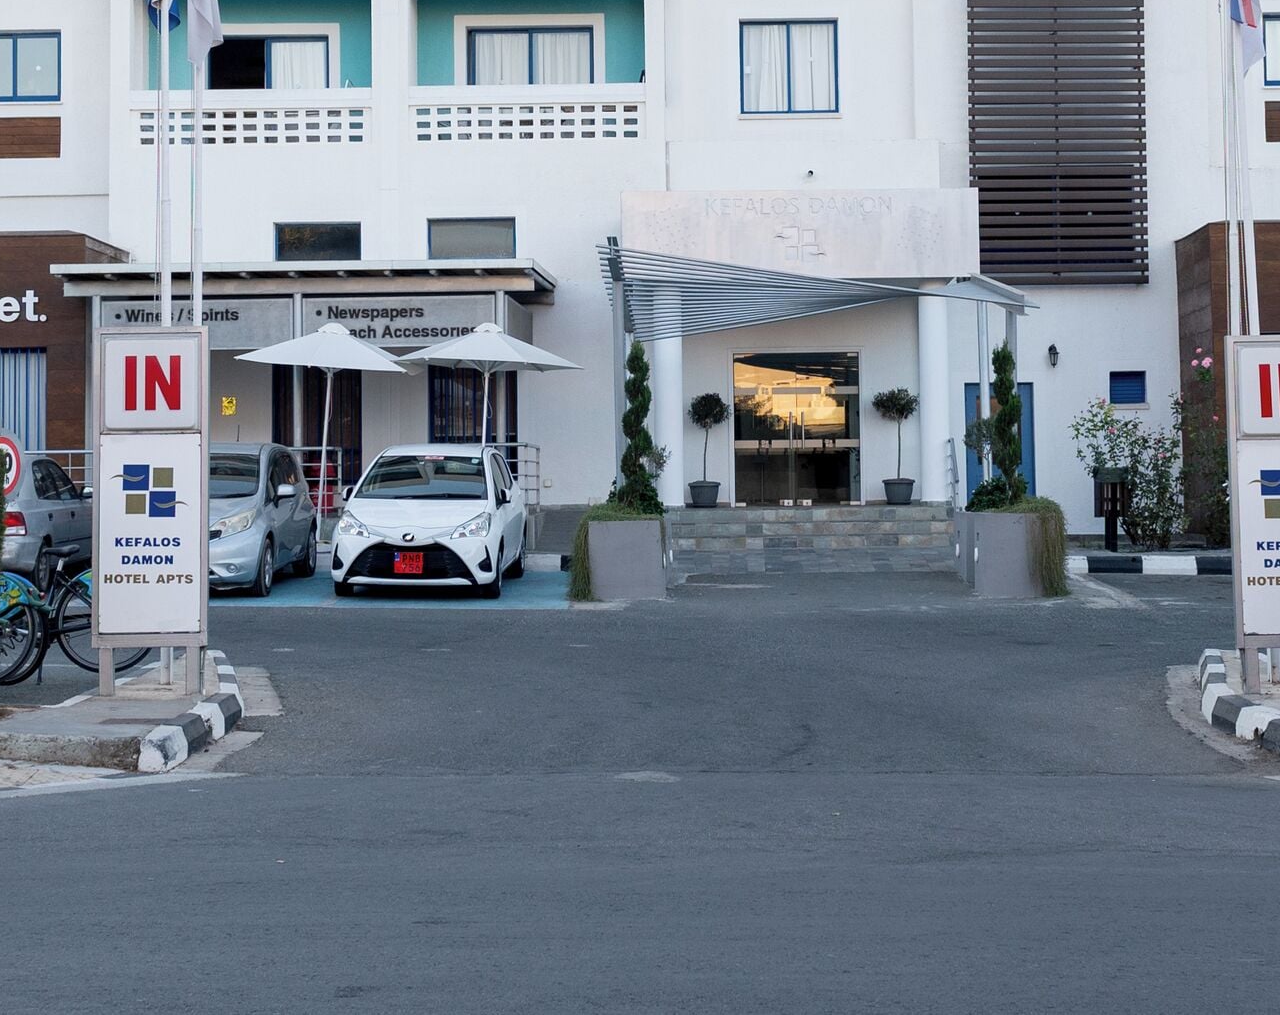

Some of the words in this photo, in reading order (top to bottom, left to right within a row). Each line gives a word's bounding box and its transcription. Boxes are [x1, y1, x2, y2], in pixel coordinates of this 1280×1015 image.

[705, 196, 800, 217] KEFALOS
[808, 196, 893, 216] DAMON
[125, 308, 174, 323] Wine
[327, 305, 425, 321] Newspapers
[349, 325, 377, 339] ach
[125, 355, 181, 411] IN
[115, 537, 181, 547] KEFALOS
[121, 555, 174, 565] DAMON
[104, 574, 150, 584] HOTEL
[156, 574, 193, 584] APTS
